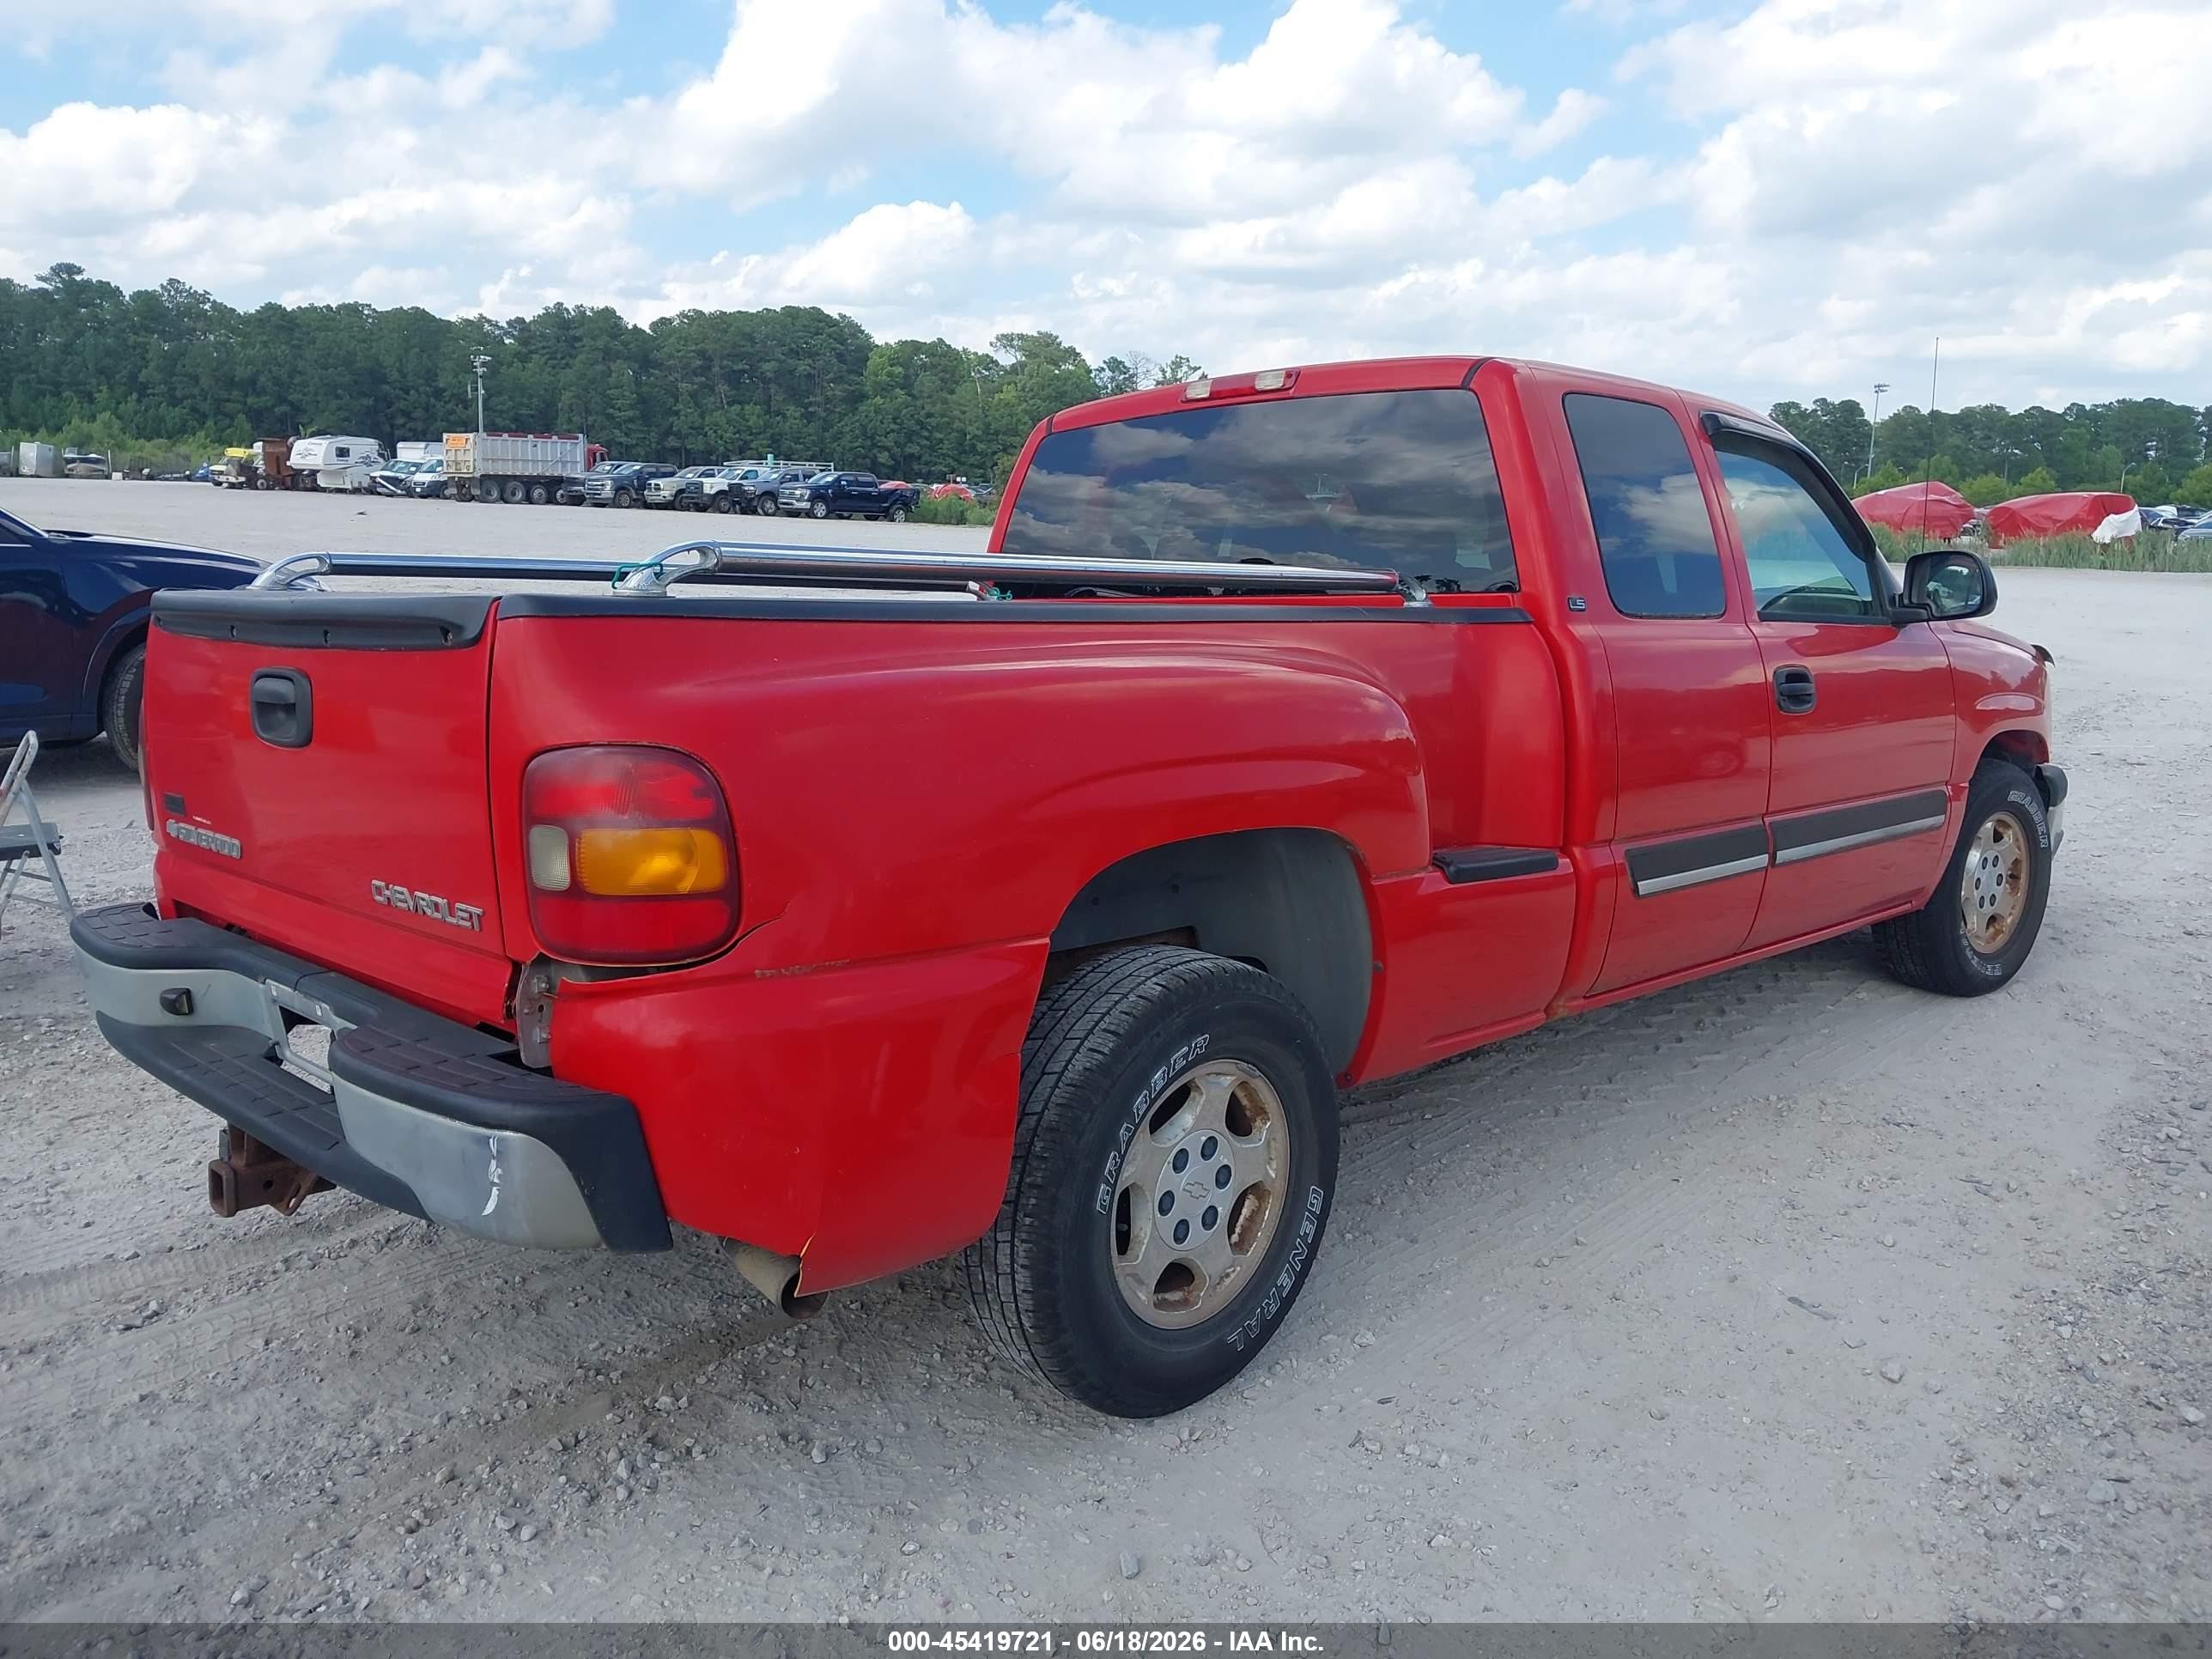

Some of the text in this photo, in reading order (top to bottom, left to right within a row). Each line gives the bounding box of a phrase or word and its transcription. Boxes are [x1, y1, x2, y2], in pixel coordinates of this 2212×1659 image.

[1569, 599, 1586, 610] LS
[371, 879, 483, 933] CHEVROLET
[1097, 1034, 1210, 1215] GRABBER
[1227, 1185, 1324, 1352] GENERAL
